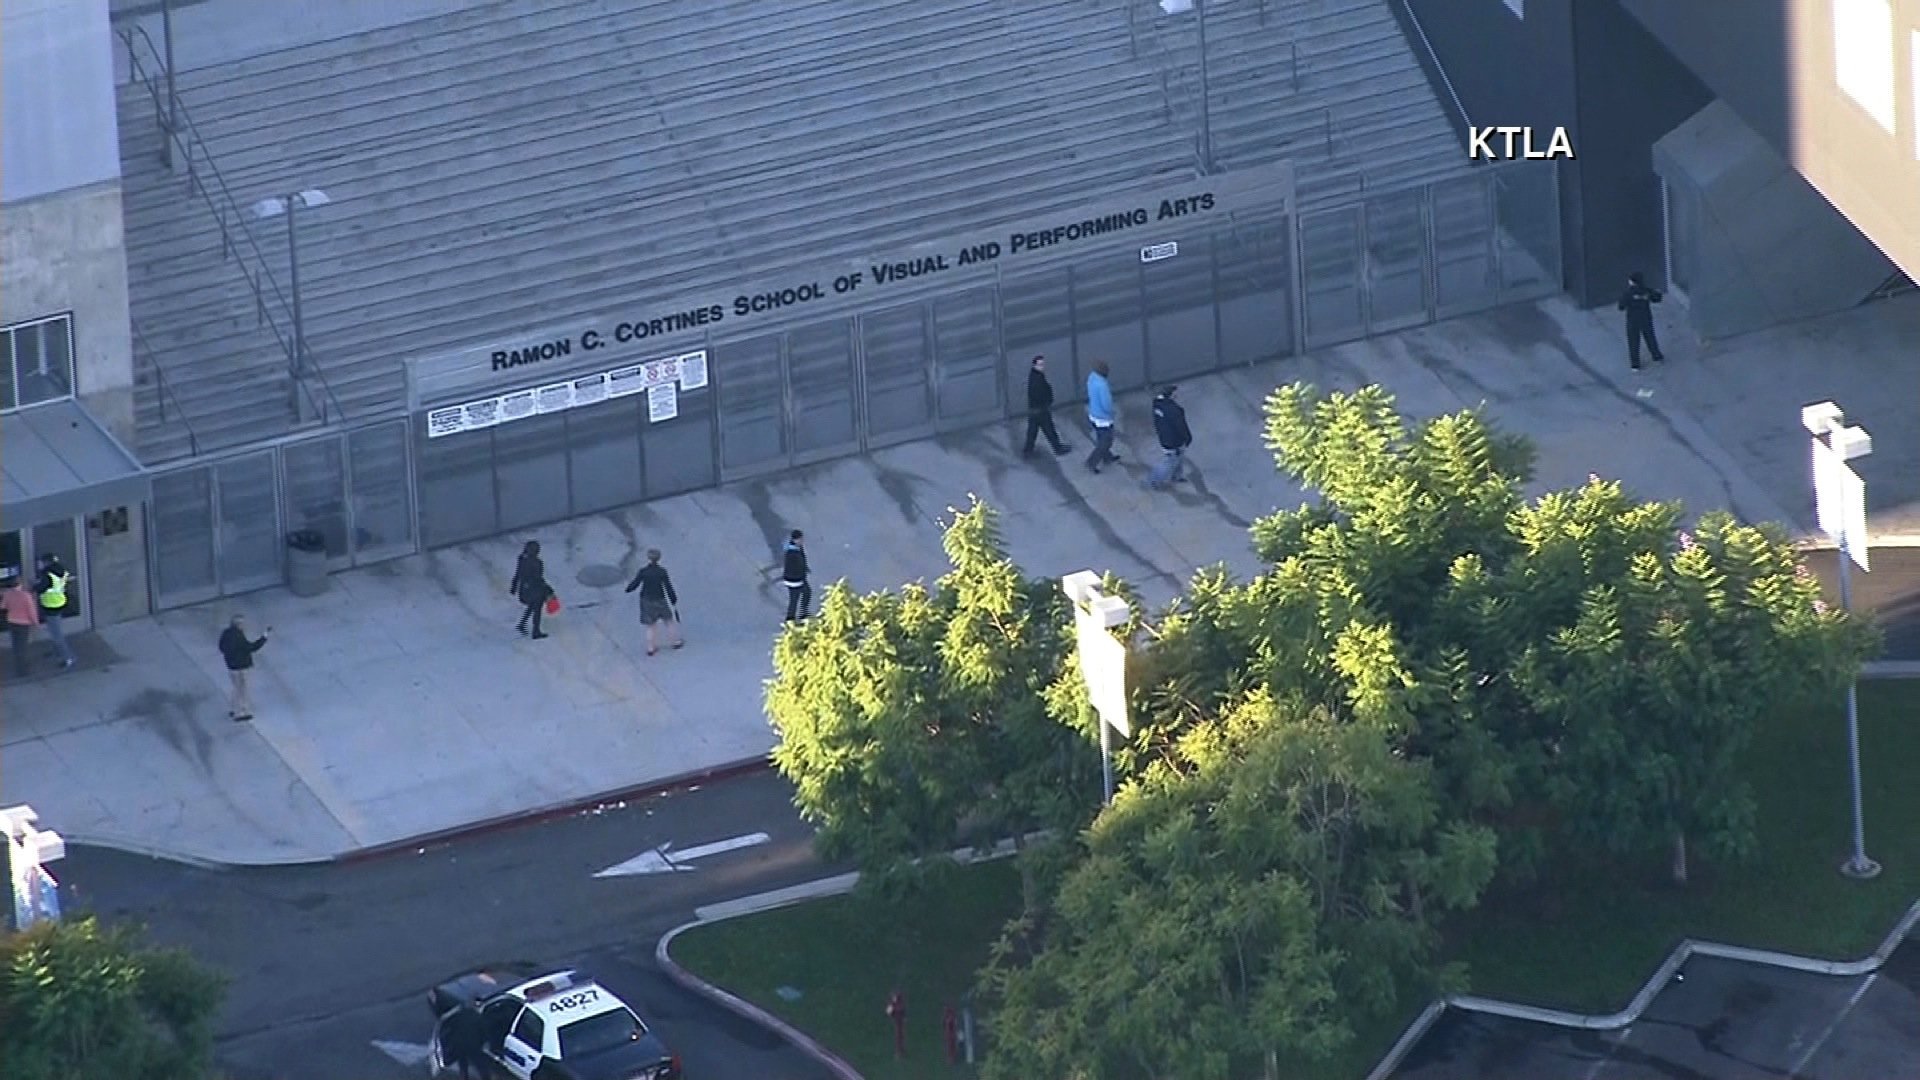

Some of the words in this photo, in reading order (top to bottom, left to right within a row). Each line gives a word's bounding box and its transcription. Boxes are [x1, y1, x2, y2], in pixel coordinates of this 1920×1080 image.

[491, 338, 571, 371] RAMON
[581, 329, 606, 351] C.
[616, 305, 723, 343] CORTINES
[734, 283, 825, 316] SCHOOL
[834, 272, 863, 294] OF
[871, 254, 949, 285] VISUAL
[958, 241, 1001, 266] AND
[1010, 208, 1149, 254] PERFORMING
[1157, 192, 1215, 221] ARTS
[549, 990, 600, 1013] 4827
